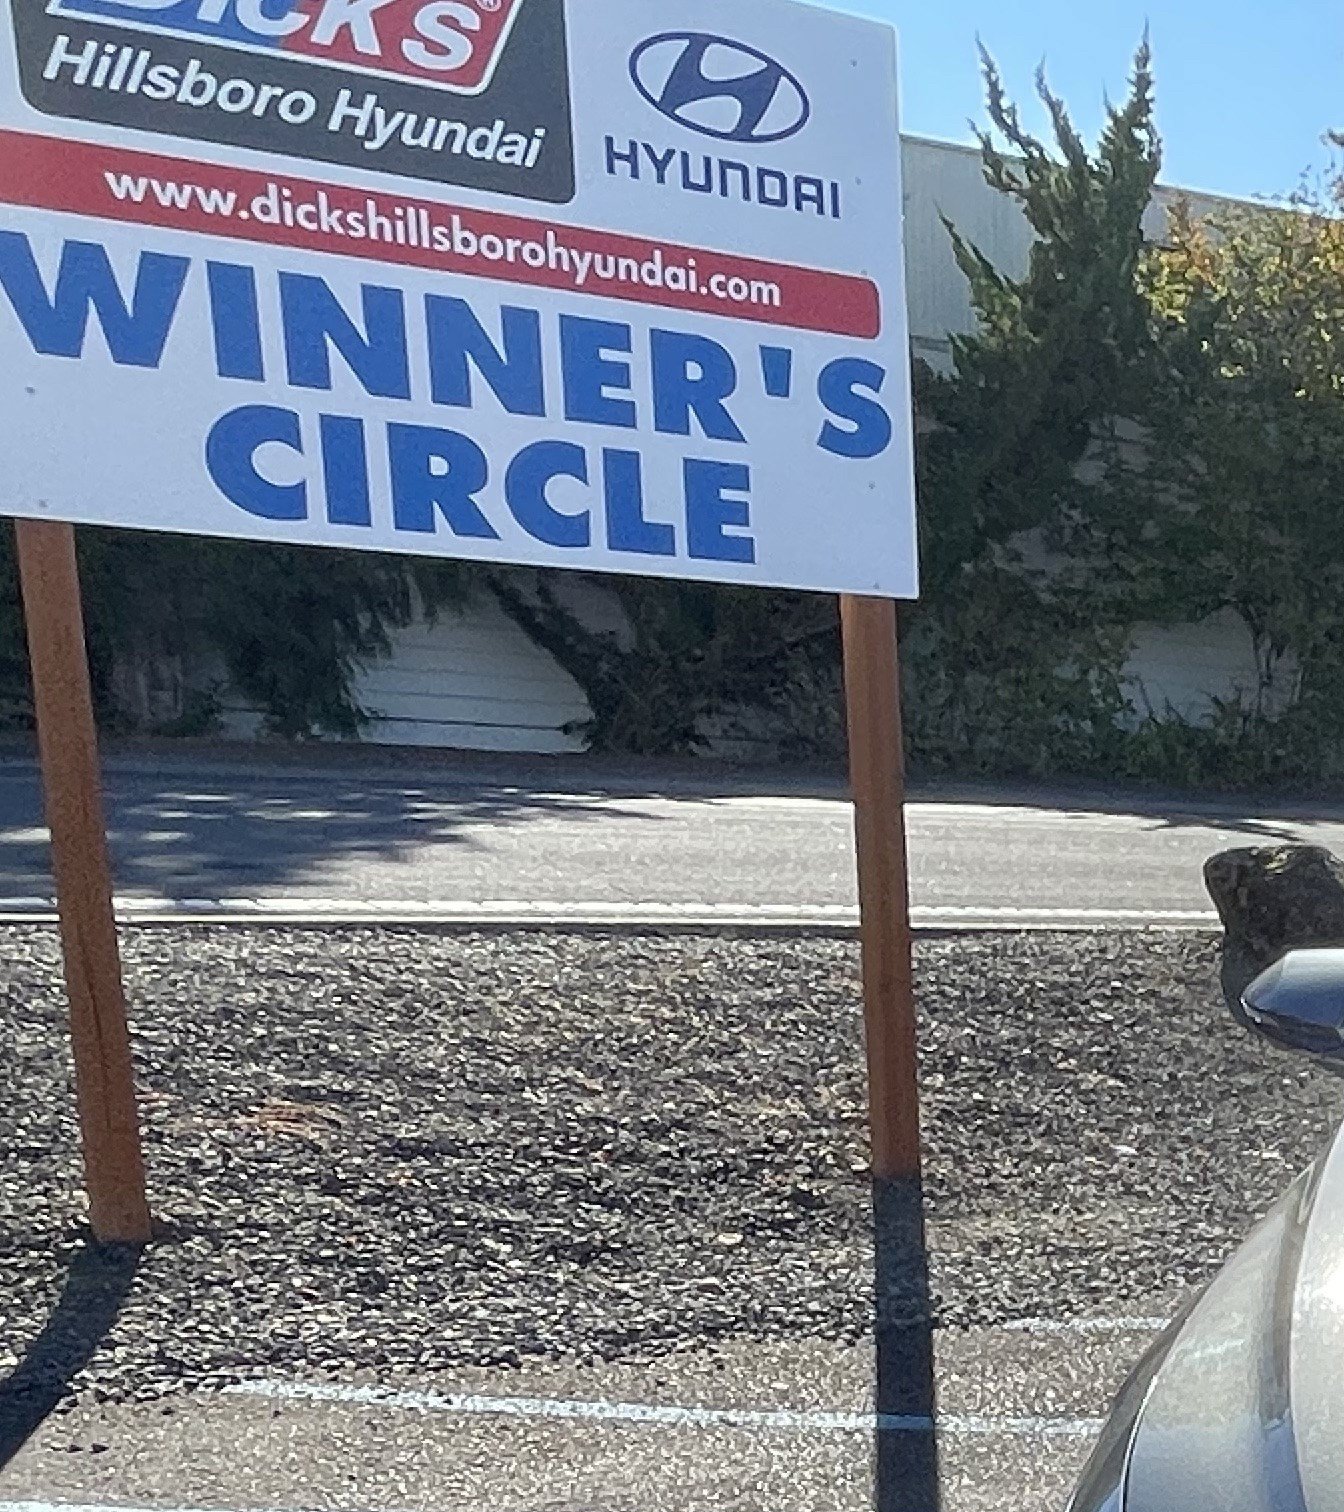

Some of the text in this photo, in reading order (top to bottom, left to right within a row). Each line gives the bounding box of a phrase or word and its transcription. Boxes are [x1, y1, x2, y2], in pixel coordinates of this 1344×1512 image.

[43, 35, 546, 168] Hillsboro Hyundai
[104, 171, 782, 307] www.dickshillsborohyundai.com
[604, 134, 842, 219] HYUNDAI
[0, 230, 893, 460] WINNER'S
[204, 404, 757, 565] CIRCLE
